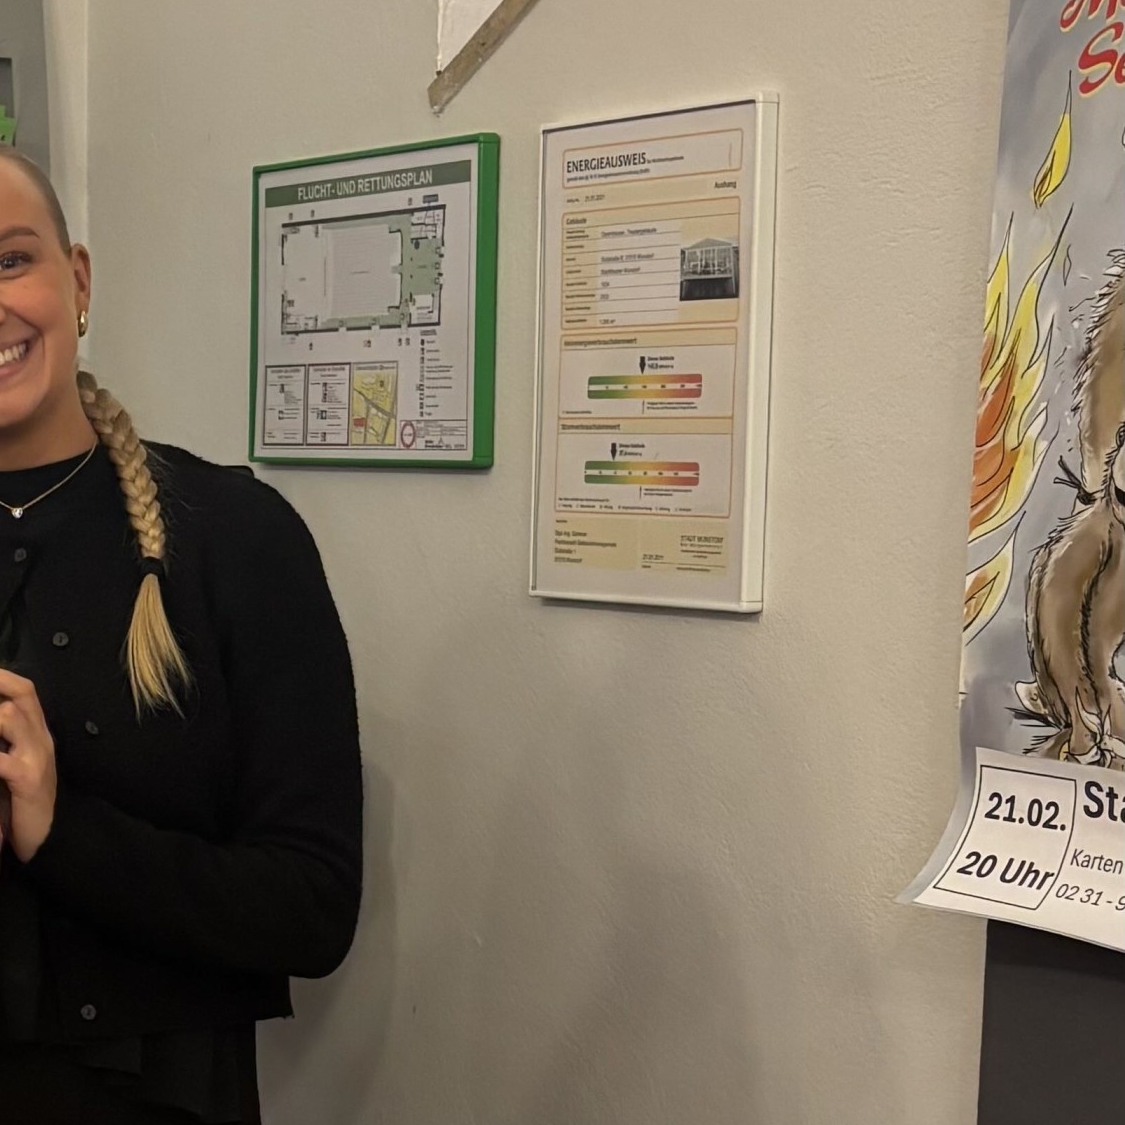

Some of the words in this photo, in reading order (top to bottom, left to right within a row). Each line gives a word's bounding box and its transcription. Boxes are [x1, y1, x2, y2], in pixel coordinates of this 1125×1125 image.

[566, 151, 647, 174] ENERGIEAUSWEIS
[298, 183, 335, 201] FLUCHT-
[336, 180, 356, 196] UND
[357, 169, 433, 193] RETTUNGSPLAN
[984, 791, 1066, 832] 21.02.
[1083, 780, 1125, 824] St
[956, 850, 998, 879] 20
[999, 857, 1055, 891] Uhr
[1070, 847, 1124, 875] Karten
